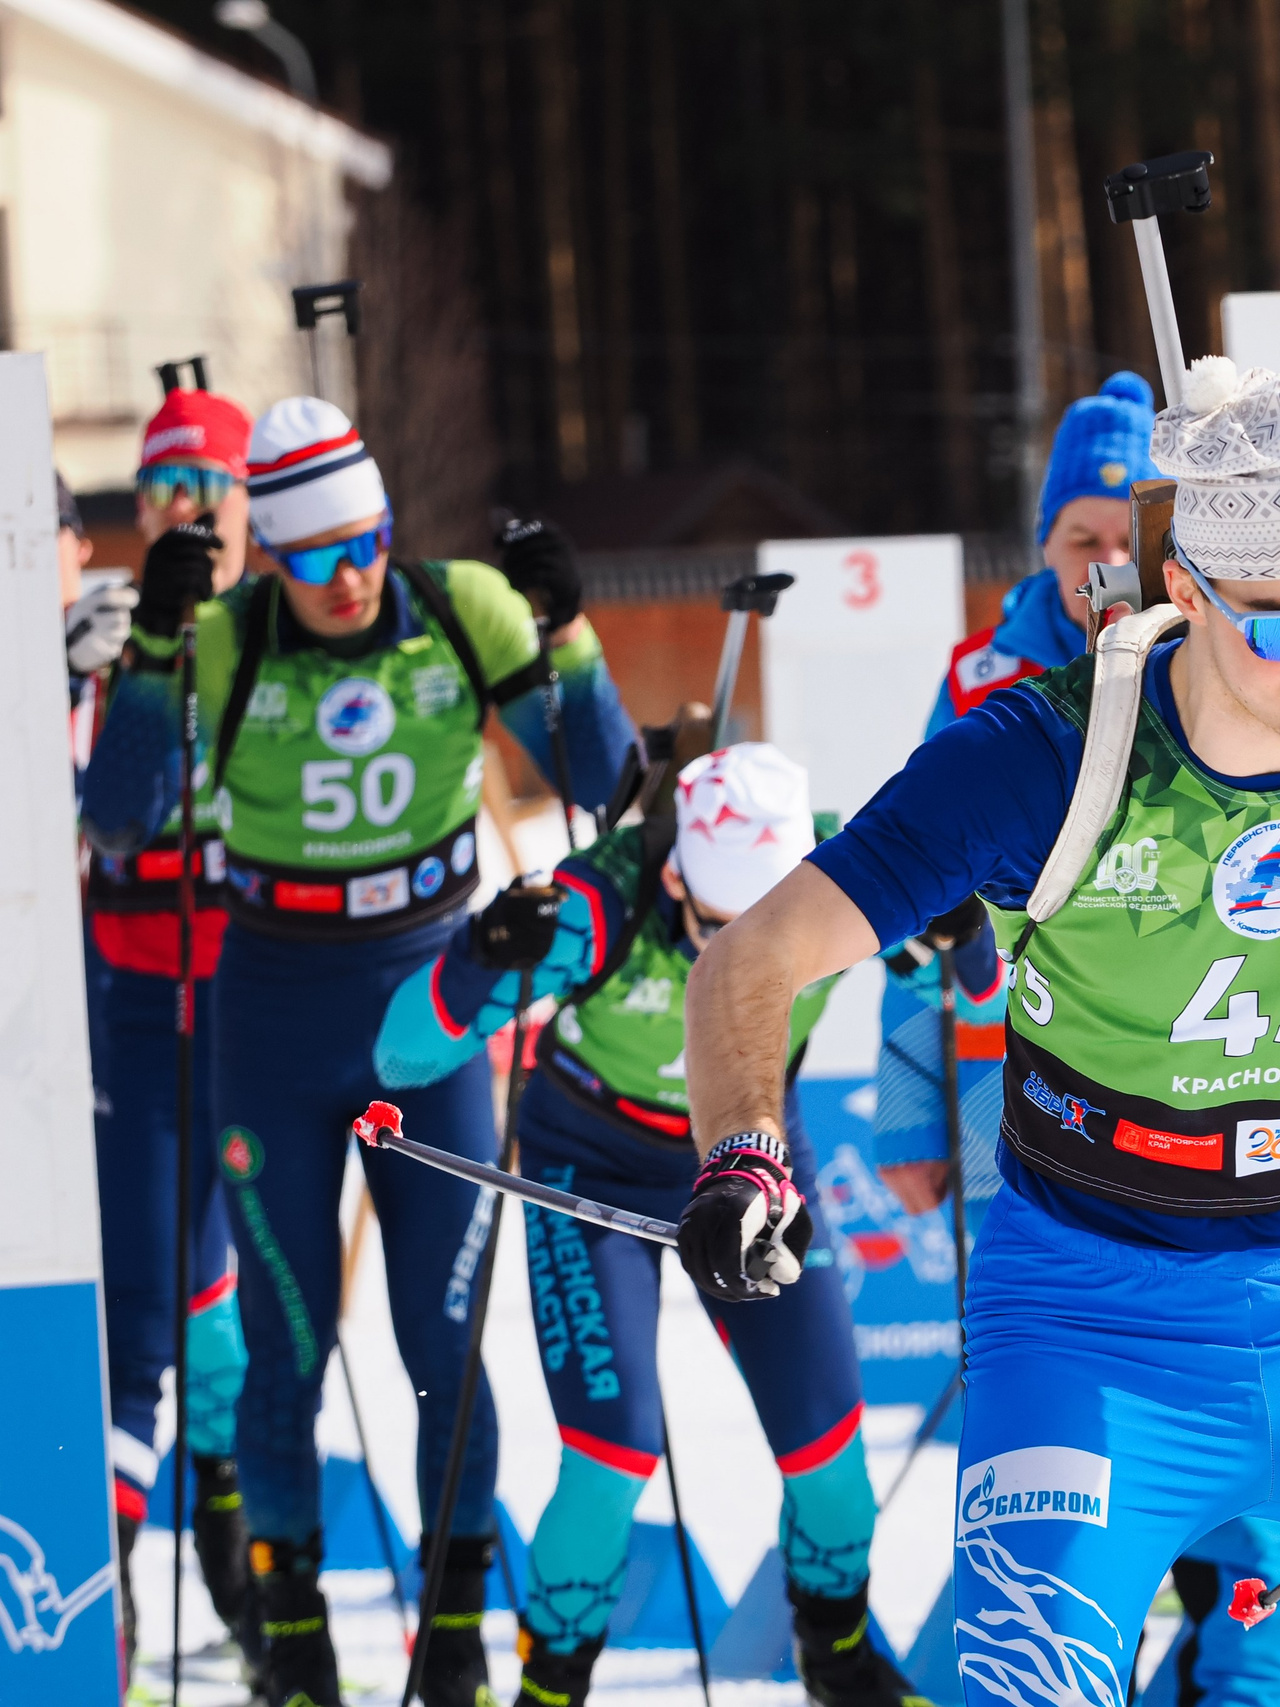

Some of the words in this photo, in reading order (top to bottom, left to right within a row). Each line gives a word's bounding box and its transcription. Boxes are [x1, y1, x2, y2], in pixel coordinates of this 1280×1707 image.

[843, 549, 883, 611] 3
[302, 752, 416, 832] 50
[1144, 851, 1161, 859] ЛЕТ
[1077, 894, 1143, 903] МИНИСТЕРСТВО
[1145, 894, 1178, 903] СПОРТА
[1072, 901, 1127, 909] РОССИЙСКОЙ
[1128, 902, 1181, 912] ФЕДЕРАЦИИ
[1148, 1140, 1171, 1150] КРАЙ
[1149, 1133, 1217, 1146] КРАСНОЯРСКИЙ
[995, 1490, 1101, 1518] GAZPROM
